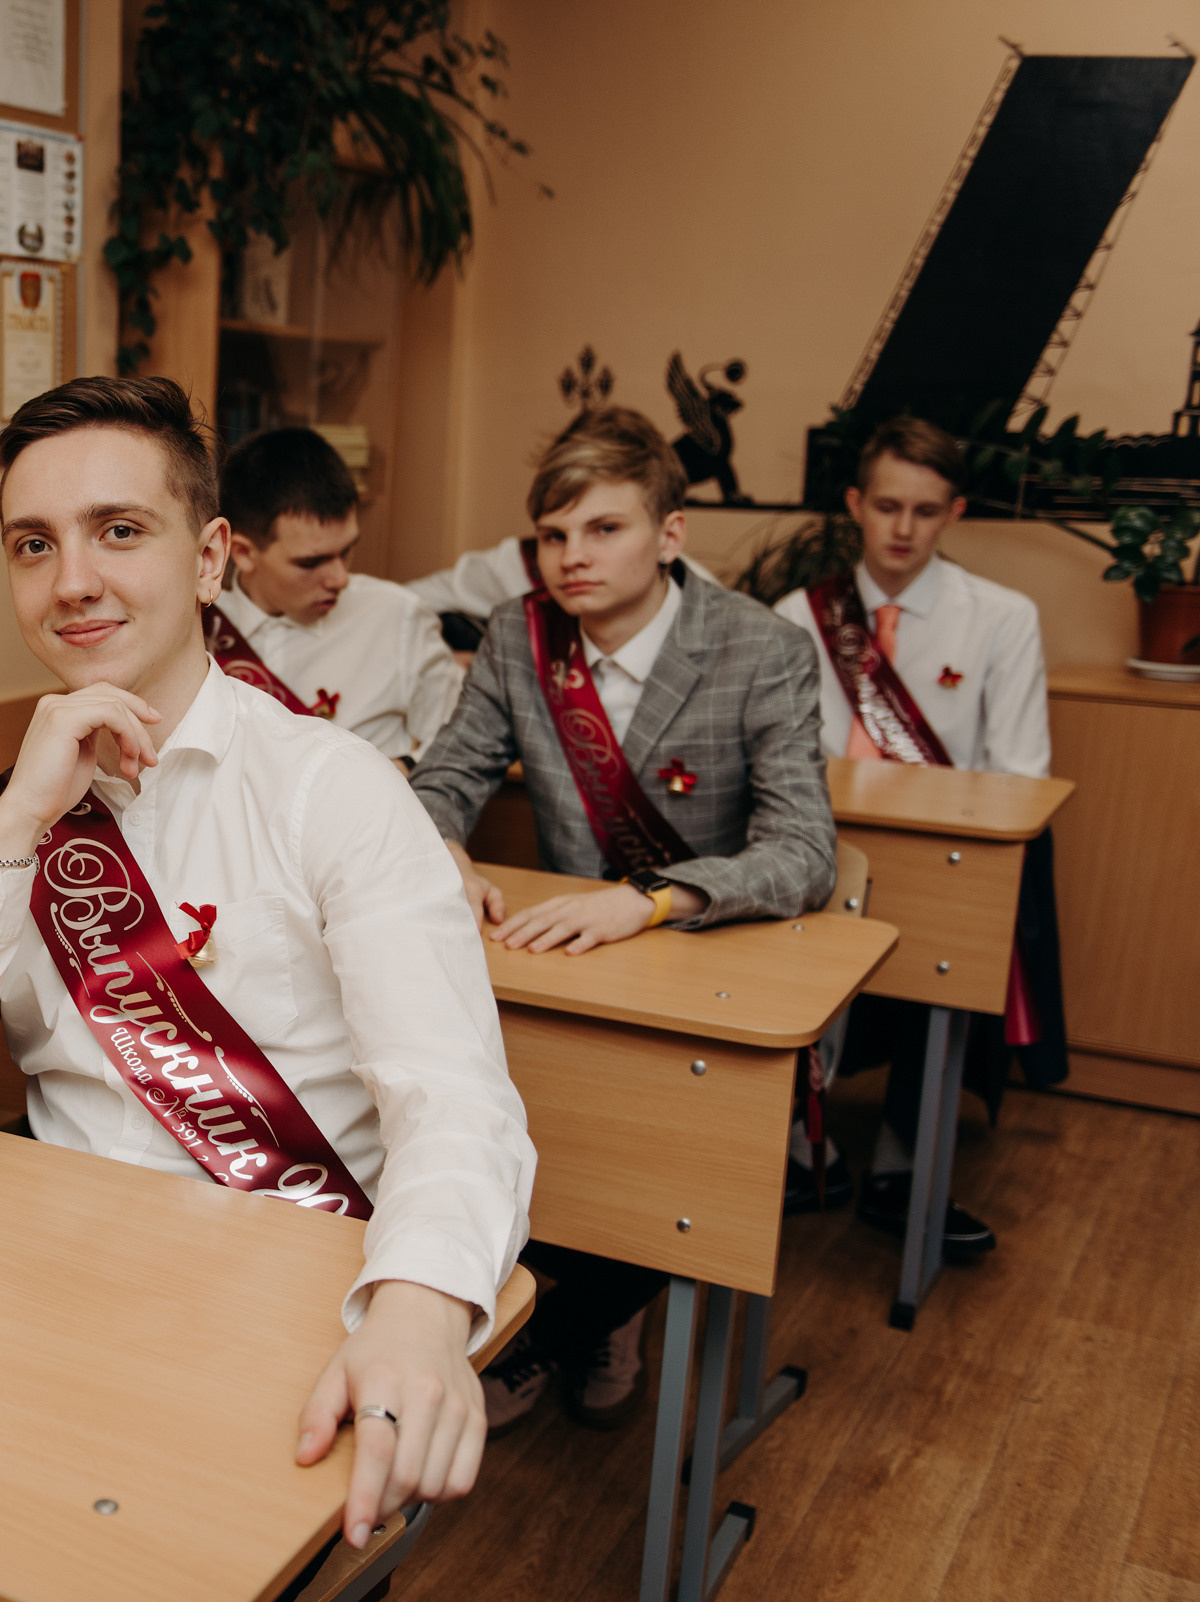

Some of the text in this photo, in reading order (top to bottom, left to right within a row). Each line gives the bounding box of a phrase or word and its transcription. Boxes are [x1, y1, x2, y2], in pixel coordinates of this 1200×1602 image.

[558, 707, 662, 870] Выпуск
[43, 837, 268, 1181] Выпускник
[110, 1026, 153, 1085] Школа
